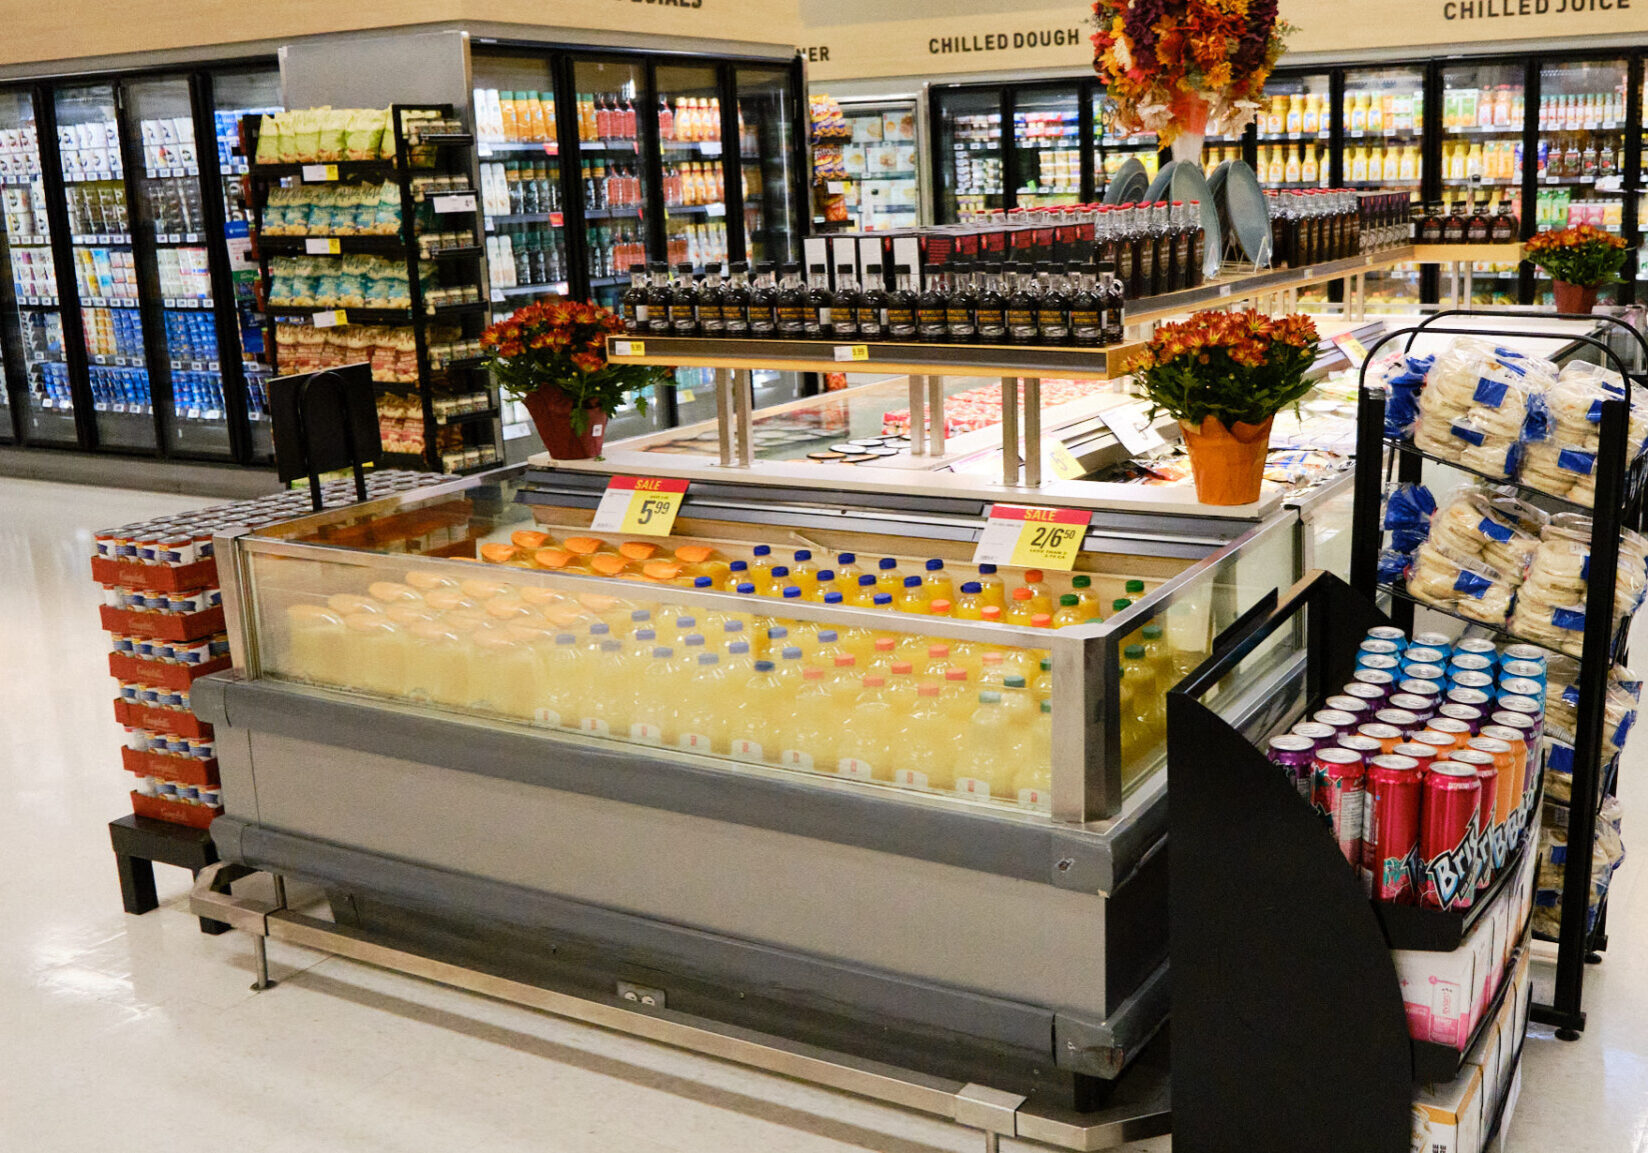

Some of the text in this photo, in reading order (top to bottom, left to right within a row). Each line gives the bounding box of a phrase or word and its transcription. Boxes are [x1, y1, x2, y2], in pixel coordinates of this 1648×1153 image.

[1444, 0, 1549, 20] CHILLED
[928, 28, 1079, 54] CHILLED DOUGH
[634, 480, 661, 490] SALE
[1023, 509, 1056, 521] SALE
